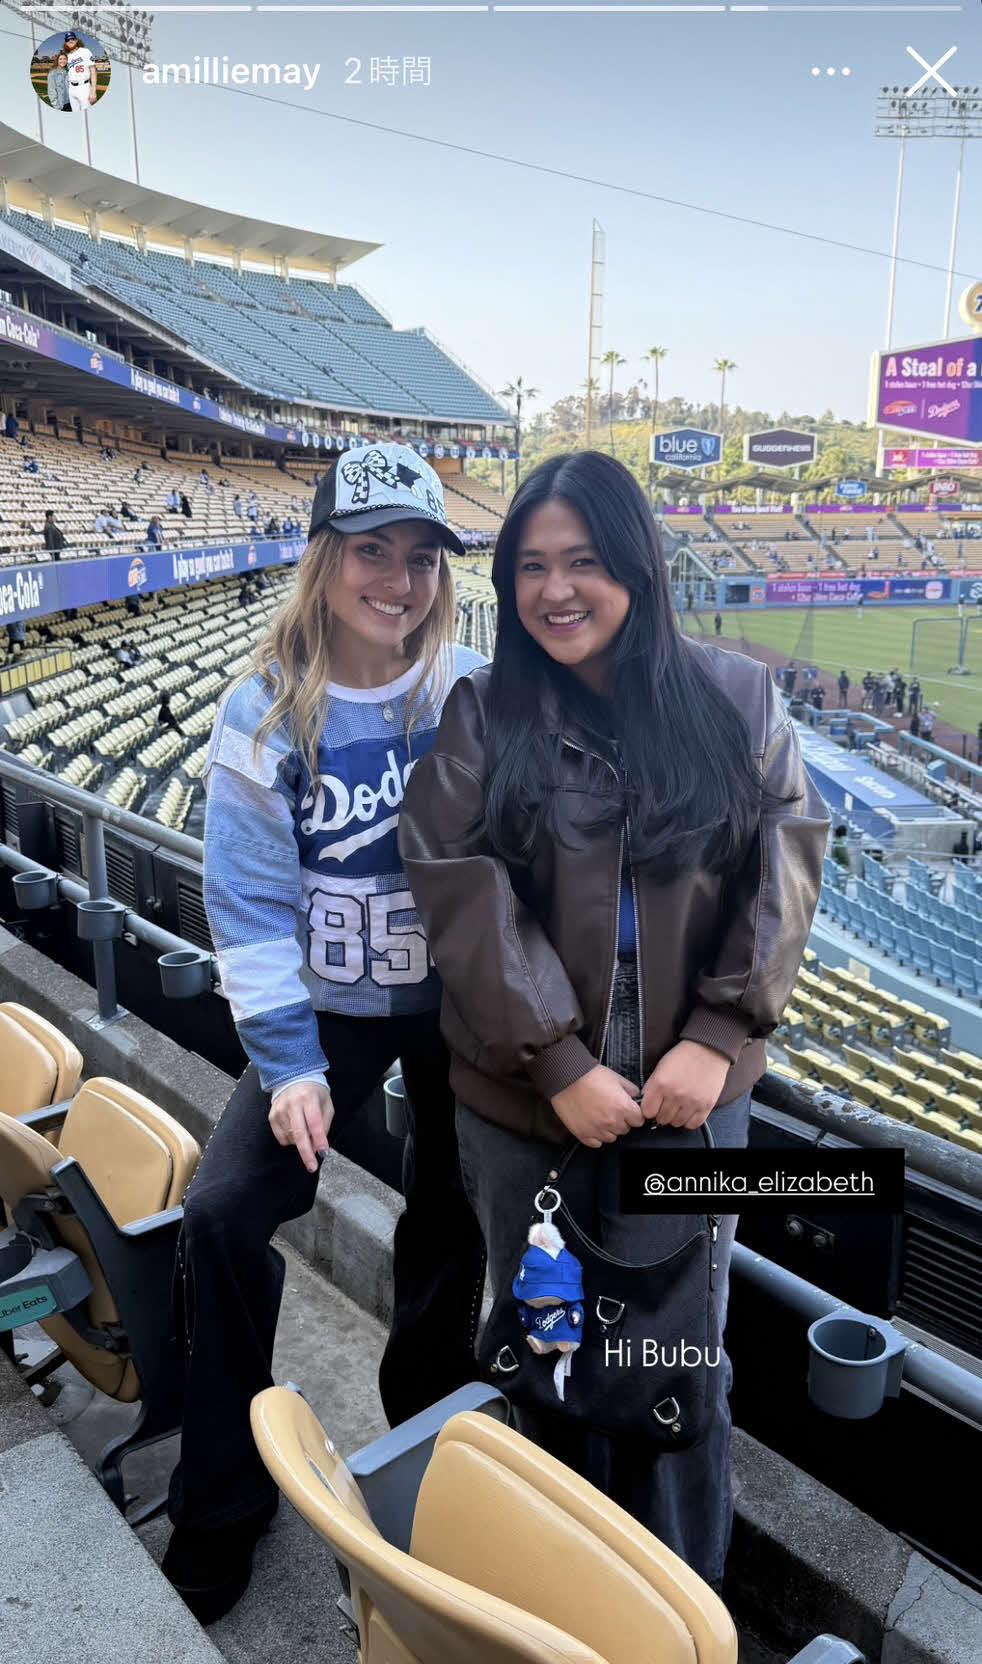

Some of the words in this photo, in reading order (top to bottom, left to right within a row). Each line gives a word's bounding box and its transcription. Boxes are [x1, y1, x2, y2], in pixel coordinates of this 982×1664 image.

[885, 356, 898, 377] A
[901, 356, 944, 377] Steal
[946, 357, 965, 377] of
[966, 361, 978, 377] a
[659, 435, 698, 453] blue
[752, 444, 812, 453] GUGGENHEIM
[664, 453, 702, 462] california
[307, 887, 430, 988] 85
[22, 1296, 48, 1309] Eats
[535, 1307, 566, 1332] Dodgers
